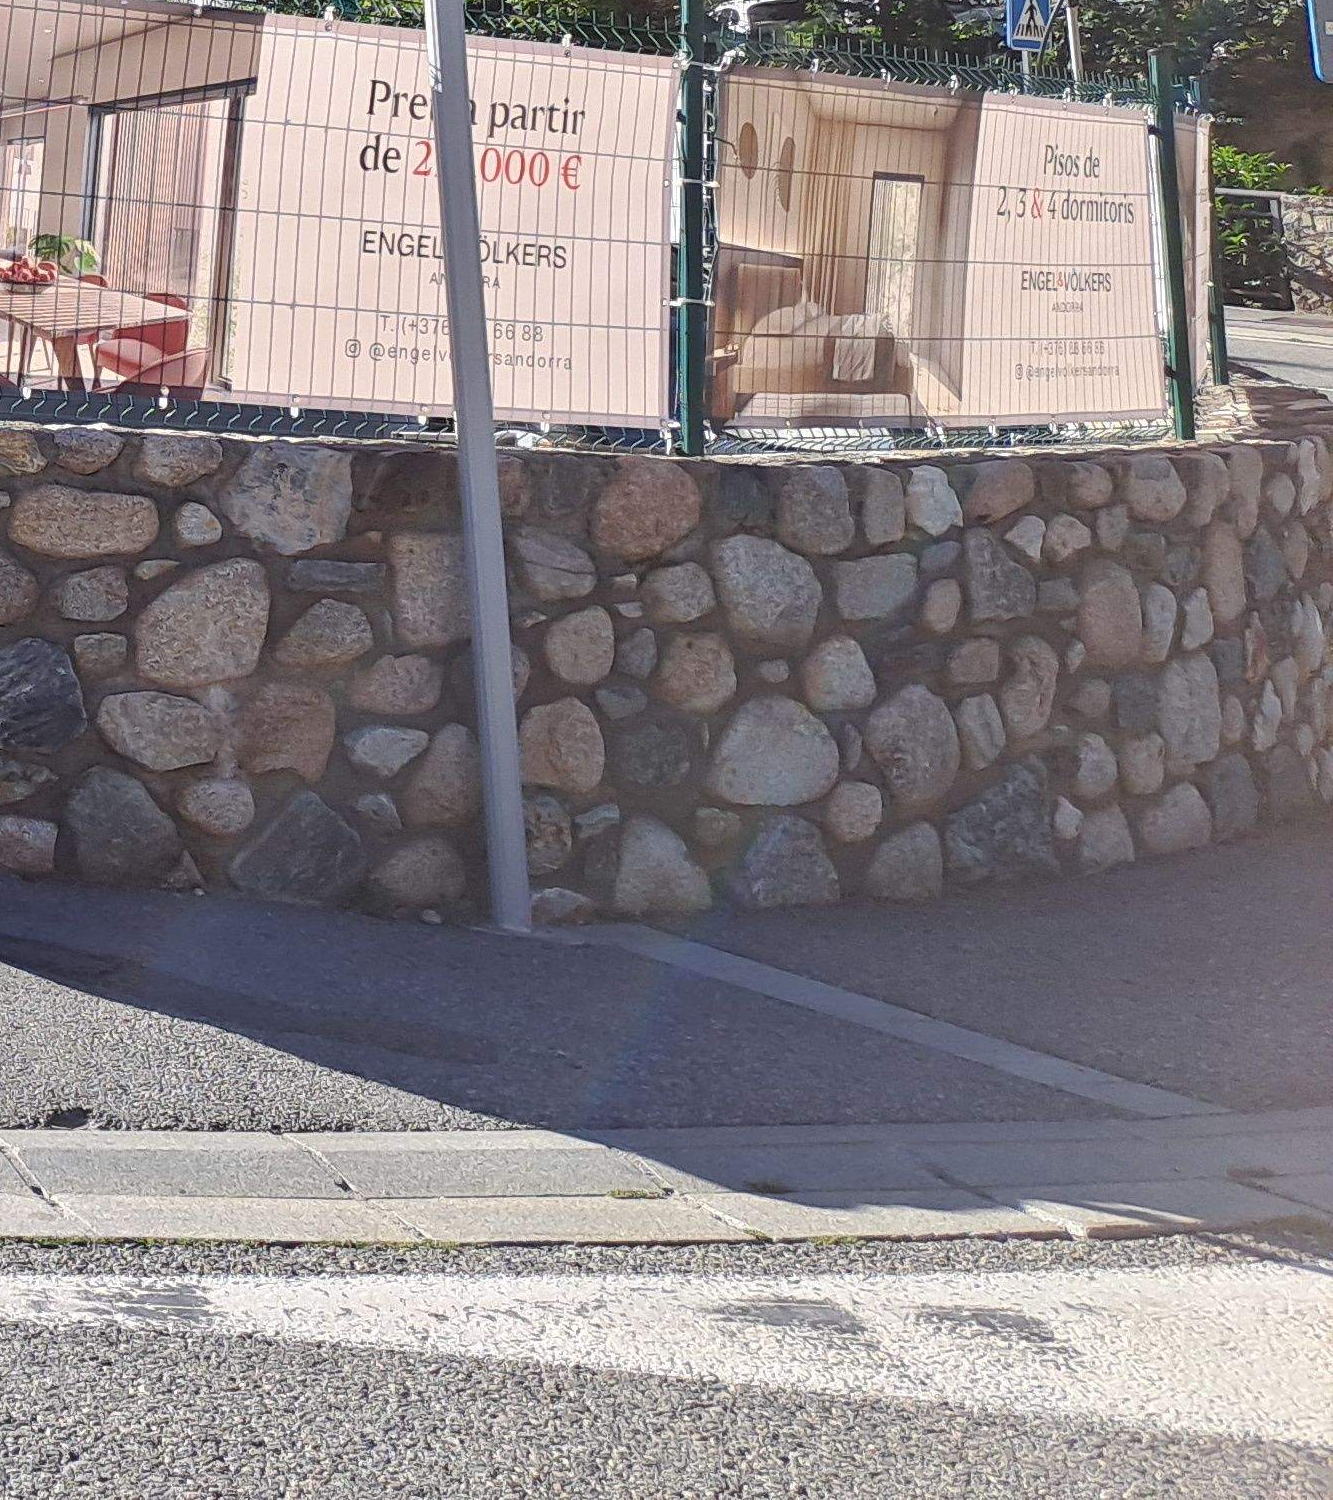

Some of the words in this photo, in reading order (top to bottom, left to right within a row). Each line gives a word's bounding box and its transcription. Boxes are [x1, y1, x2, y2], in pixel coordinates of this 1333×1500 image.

[366, 79, 435, 121] Pre
[488, 96, 586, 139] partir
[359, 134, 402, 174] de
[560, 154, 583, 190] €
[1043, 144, 1080, 178] Pisos
[1083, 146, 1100, 178] de
[997, 185, 1011, 223] 2,
[1016, 187, 1026, 218] 3
[1030, 187, 1043, 219] &
[1047, 190, 1057, 219] 4
[1061, 188, 1135, 224] dormitoris
[362, 230, 567, 269] ENGELÖLKERS
[429, 272, 501, 289] ANRA
[380, 314, 394, 332] T.
[402, 317, 450, 336] (+376
[494, 323, 515, 340] 66
[522, 324, 543, 342] 88
